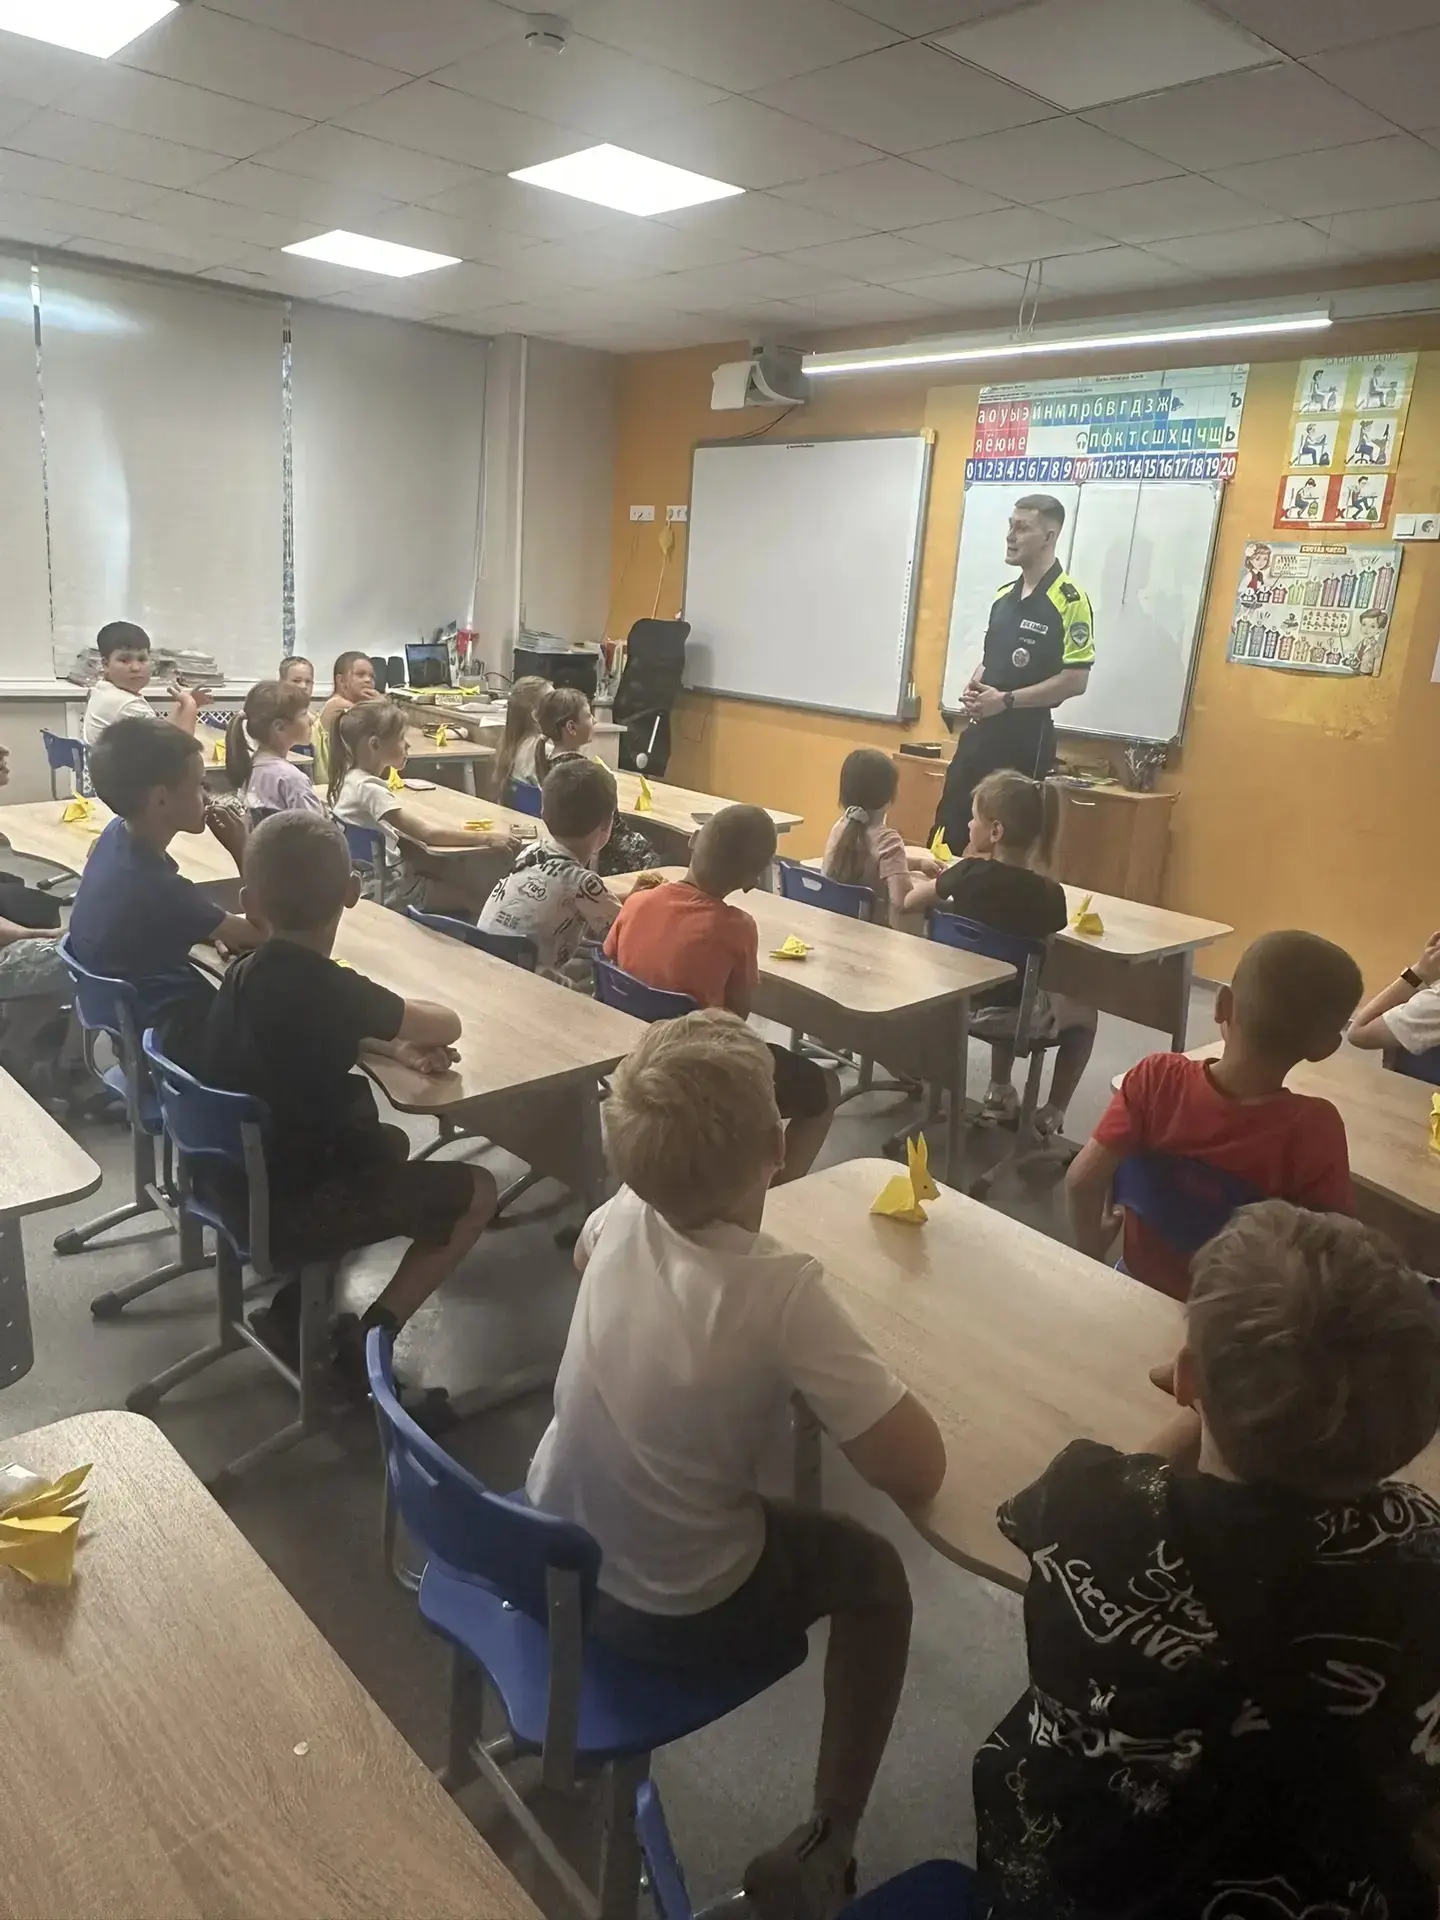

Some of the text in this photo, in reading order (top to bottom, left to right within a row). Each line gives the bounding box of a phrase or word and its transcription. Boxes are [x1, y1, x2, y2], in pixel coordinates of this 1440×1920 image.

[967, 457, 1236, 479] 0 1 2 3 4 5 6 7 8 9 10 11 12 13 14 15 16 17 18 19 20
